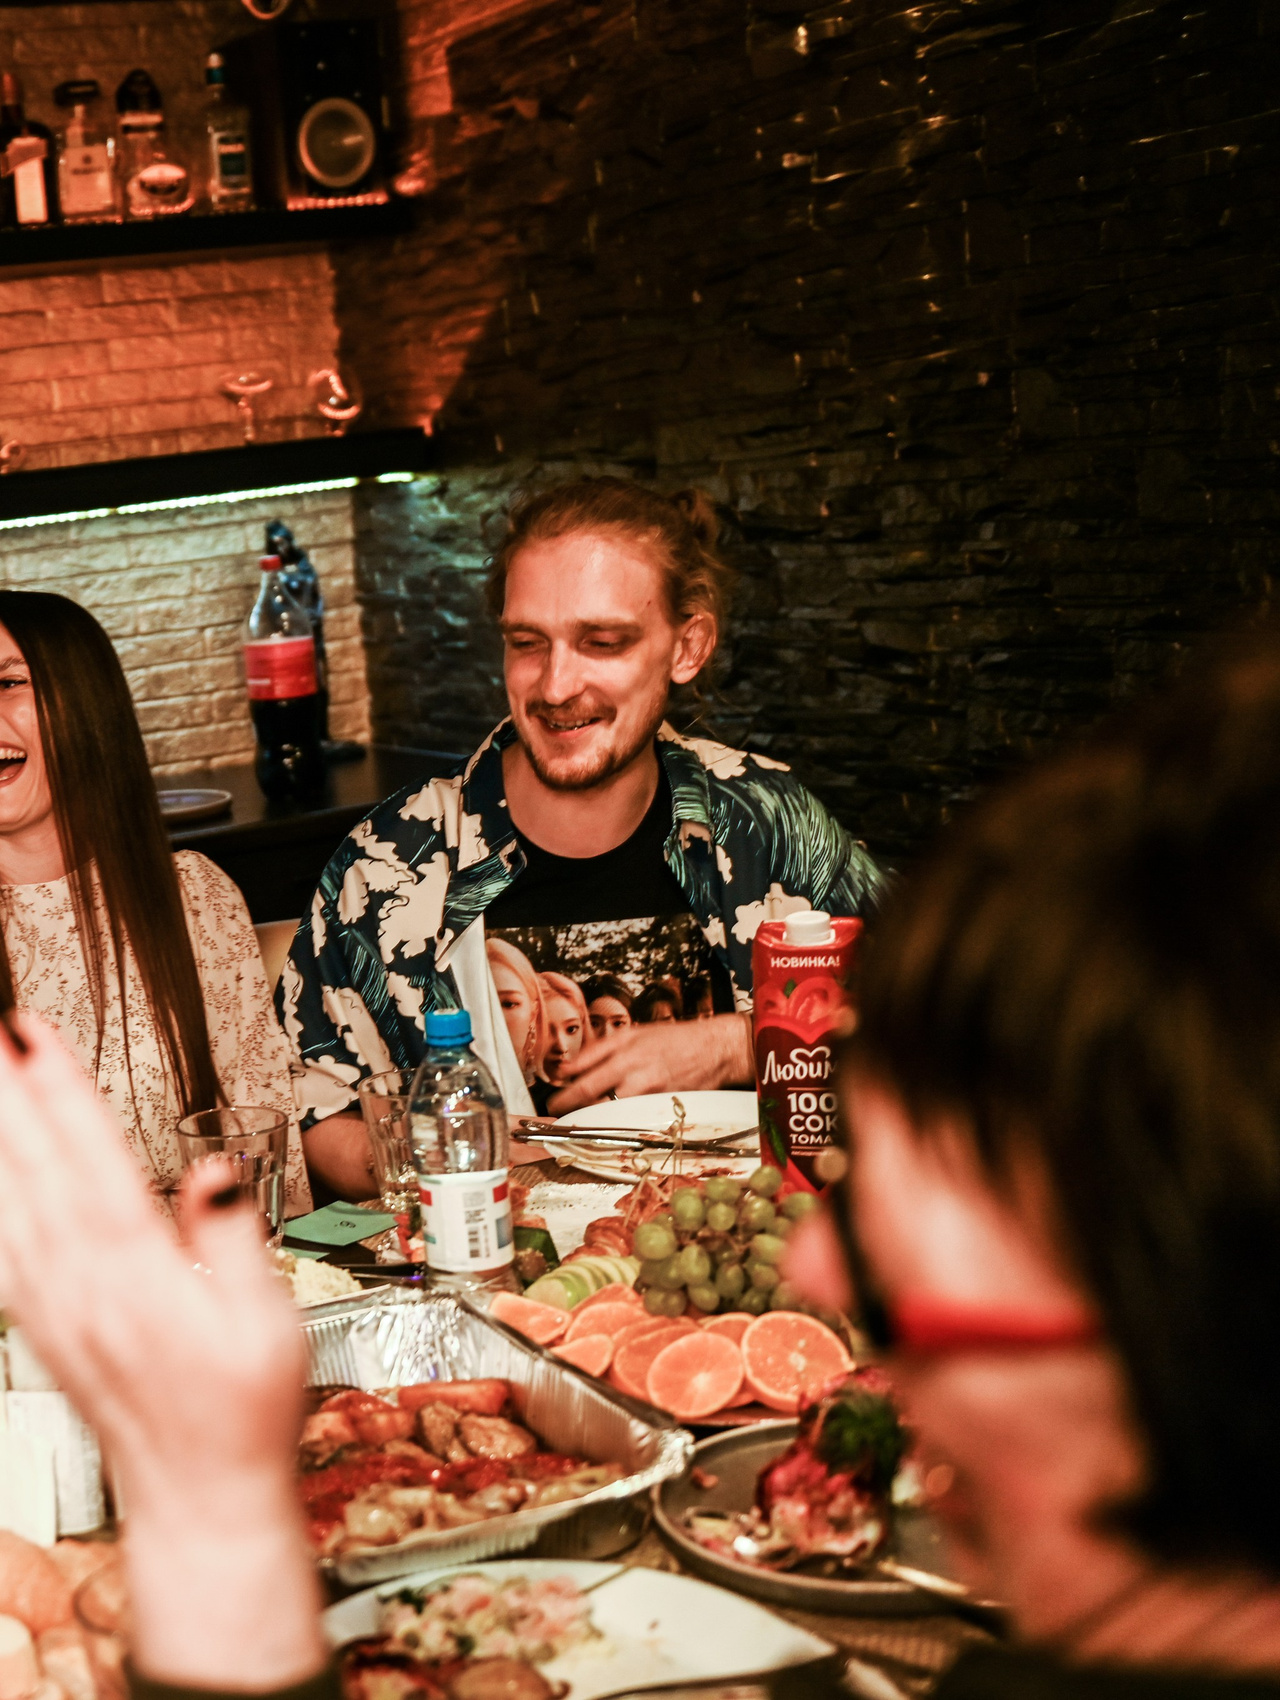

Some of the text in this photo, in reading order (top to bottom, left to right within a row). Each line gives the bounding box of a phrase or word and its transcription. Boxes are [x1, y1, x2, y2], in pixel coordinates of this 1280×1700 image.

[771, 955, 840, 968] НОВИНКА!
[787, 1092, 838, 1113] 100
[789, 1114, 838, 1132] СОК
[790, 1133, 834, 1144] ТОМА
